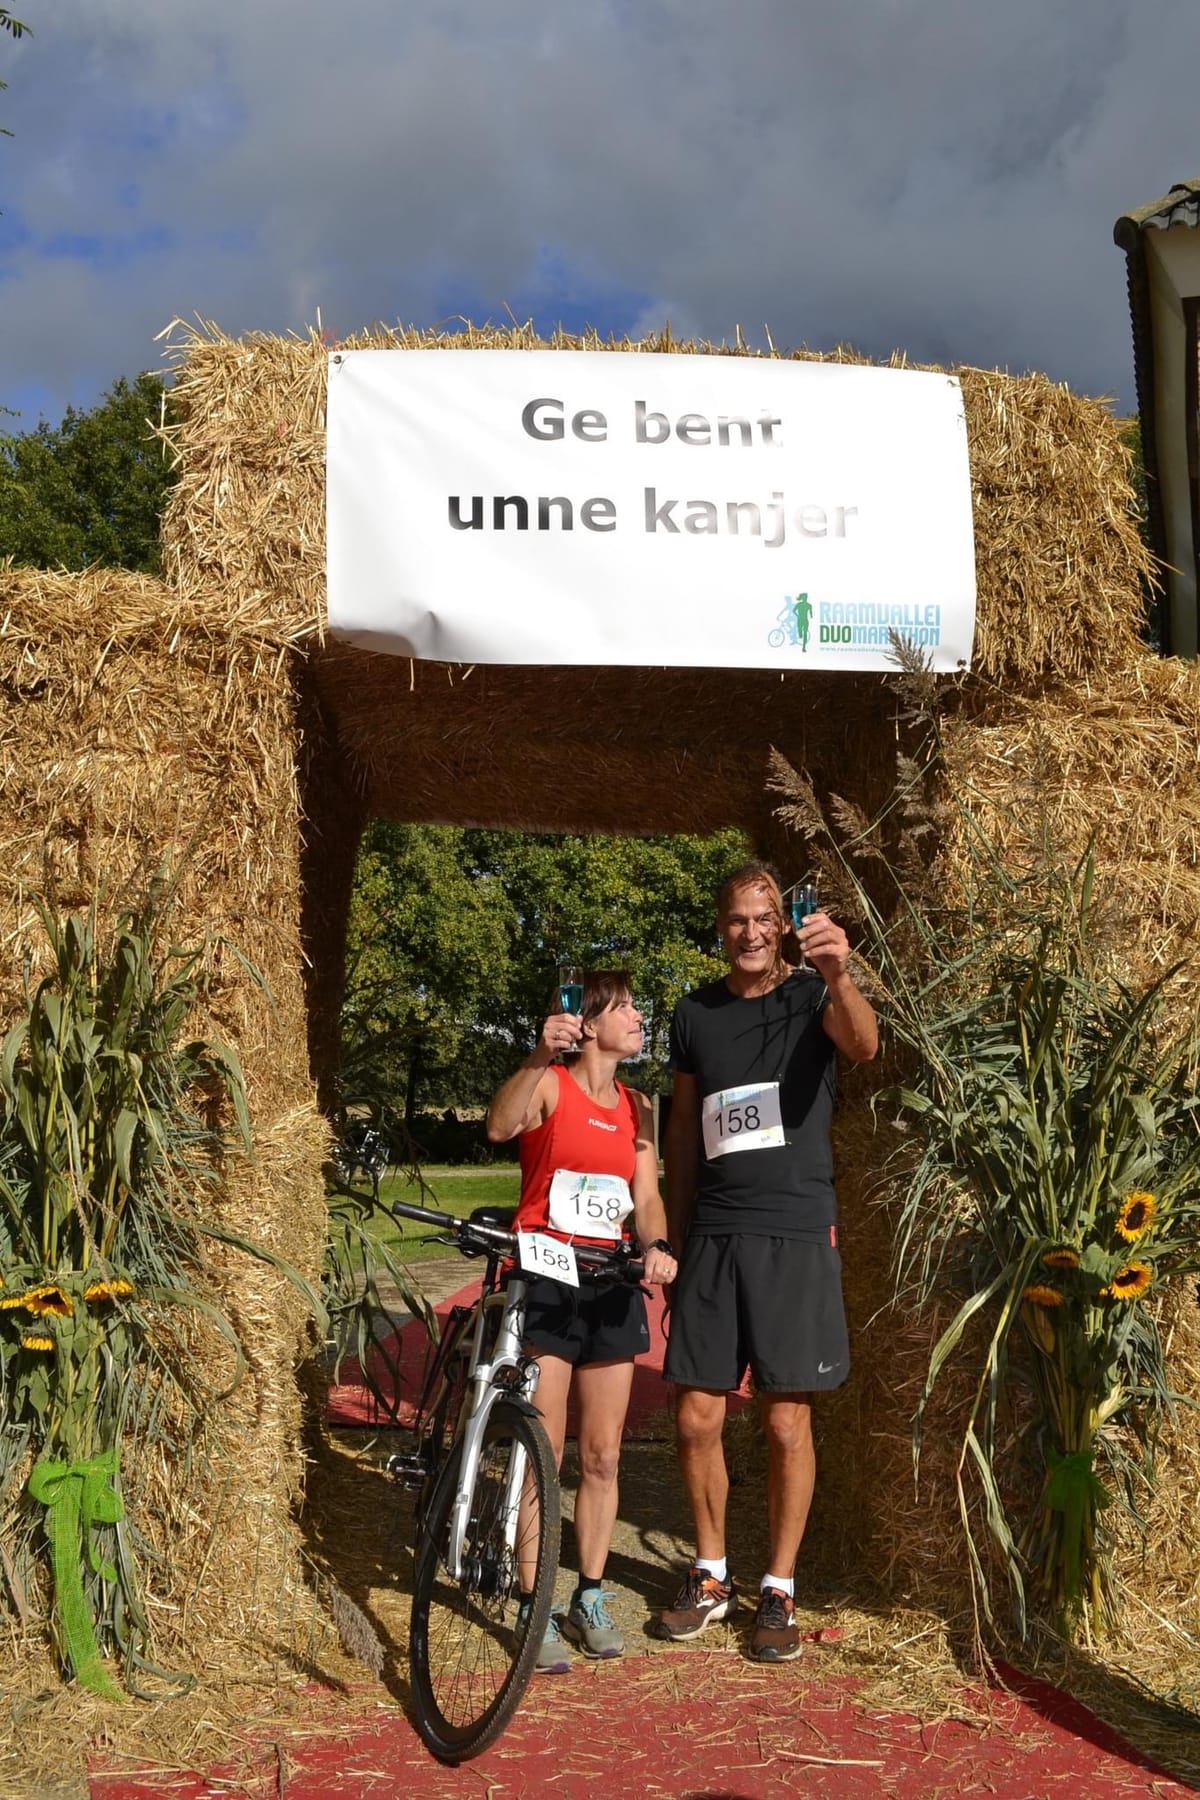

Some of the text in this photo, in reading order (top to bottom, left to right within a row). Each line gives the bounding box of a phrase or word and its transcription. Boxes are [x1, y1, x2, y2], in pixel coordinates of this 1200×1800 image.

[521, 397, 784, 448] Ge bent
[447, 486, 858, 549] unne kanjer
[819, 601, 941, 626] RAAMVALLEI
[819, 624, 940, 646] DUOMARTHON
[714, 1105, 761, 1137] 158
[569, 1192, 621, 1222] 158
[528, 1245, 570, 1272] 158
